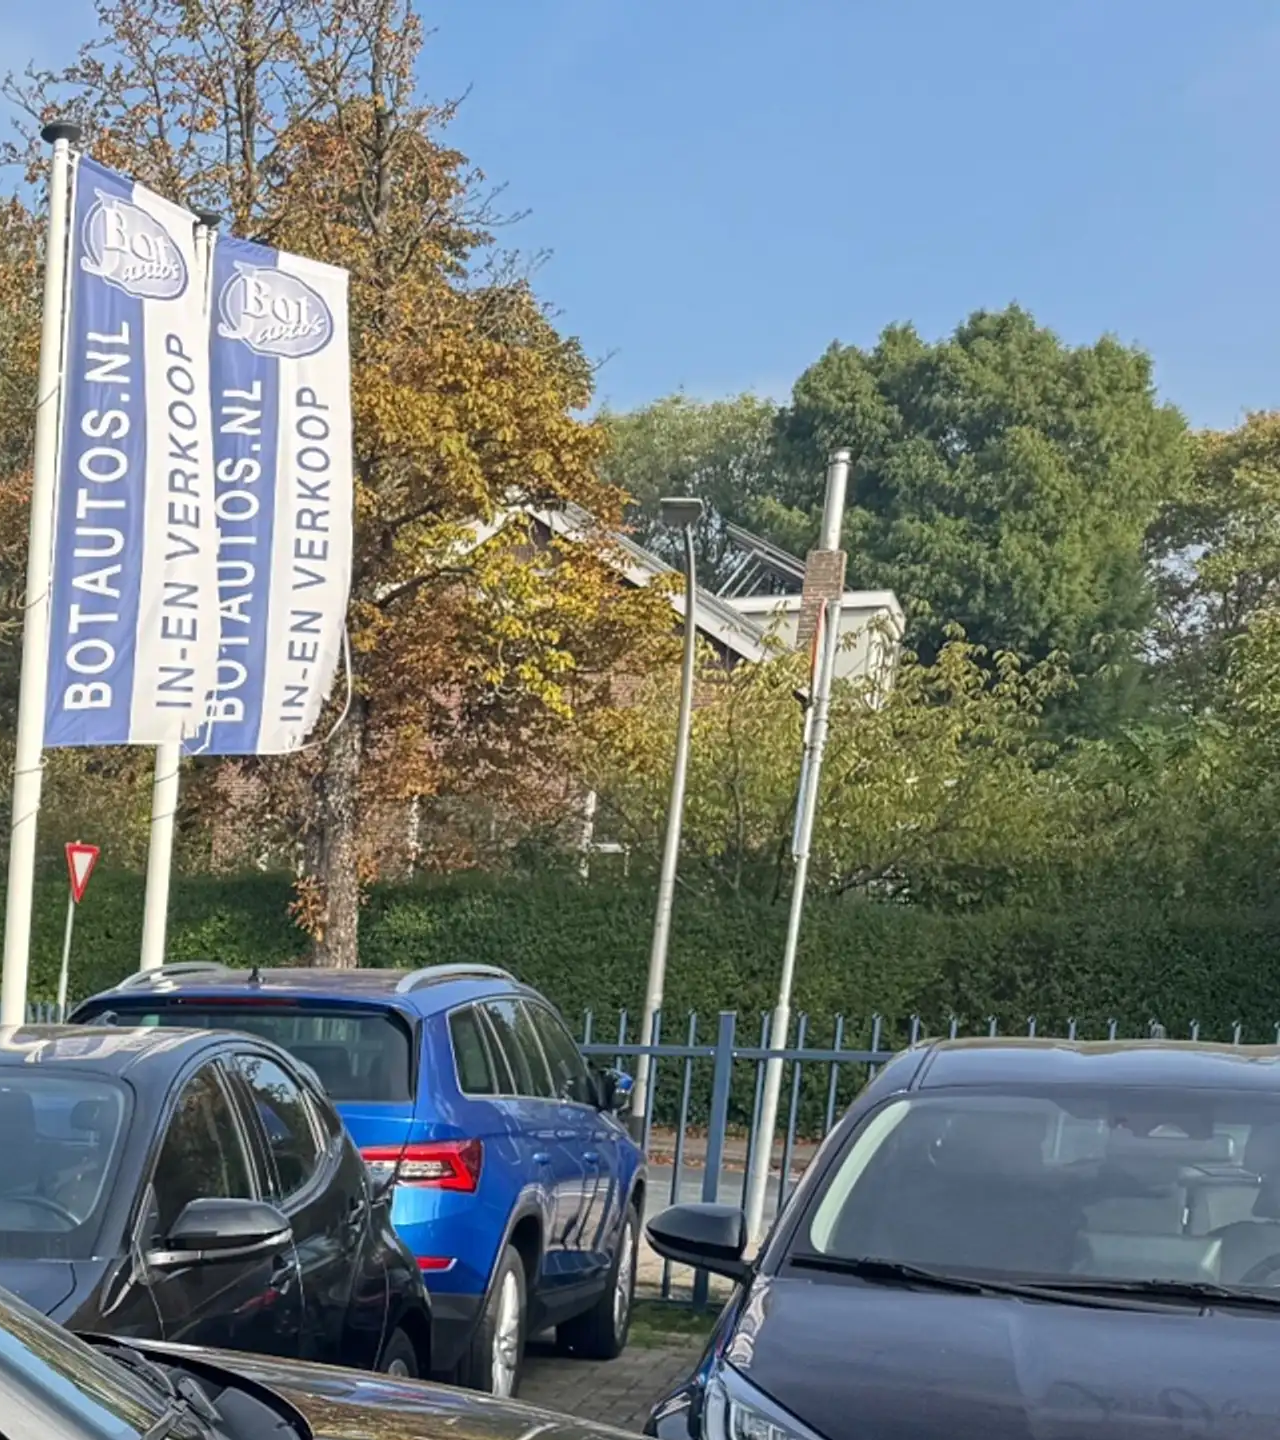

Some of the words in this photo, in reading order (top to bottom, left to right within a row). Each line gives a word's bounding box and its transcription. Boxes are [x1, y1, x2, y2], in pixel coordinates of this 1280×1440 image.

[103, 206, 170, 264] Bot
[241, 275, 310, 324] Bot
[63, 320, 131, 711] BOTAUTOS.NL
[164, 332, 202, 571] VERKOOP
[292, 386, 332, 592] VERKOOP
[212, 379, 263, 723] BOTAUTOS.NL
[155, 579, 200, 709] IN-EN
[279, 606, 323, 723] IN-EN
